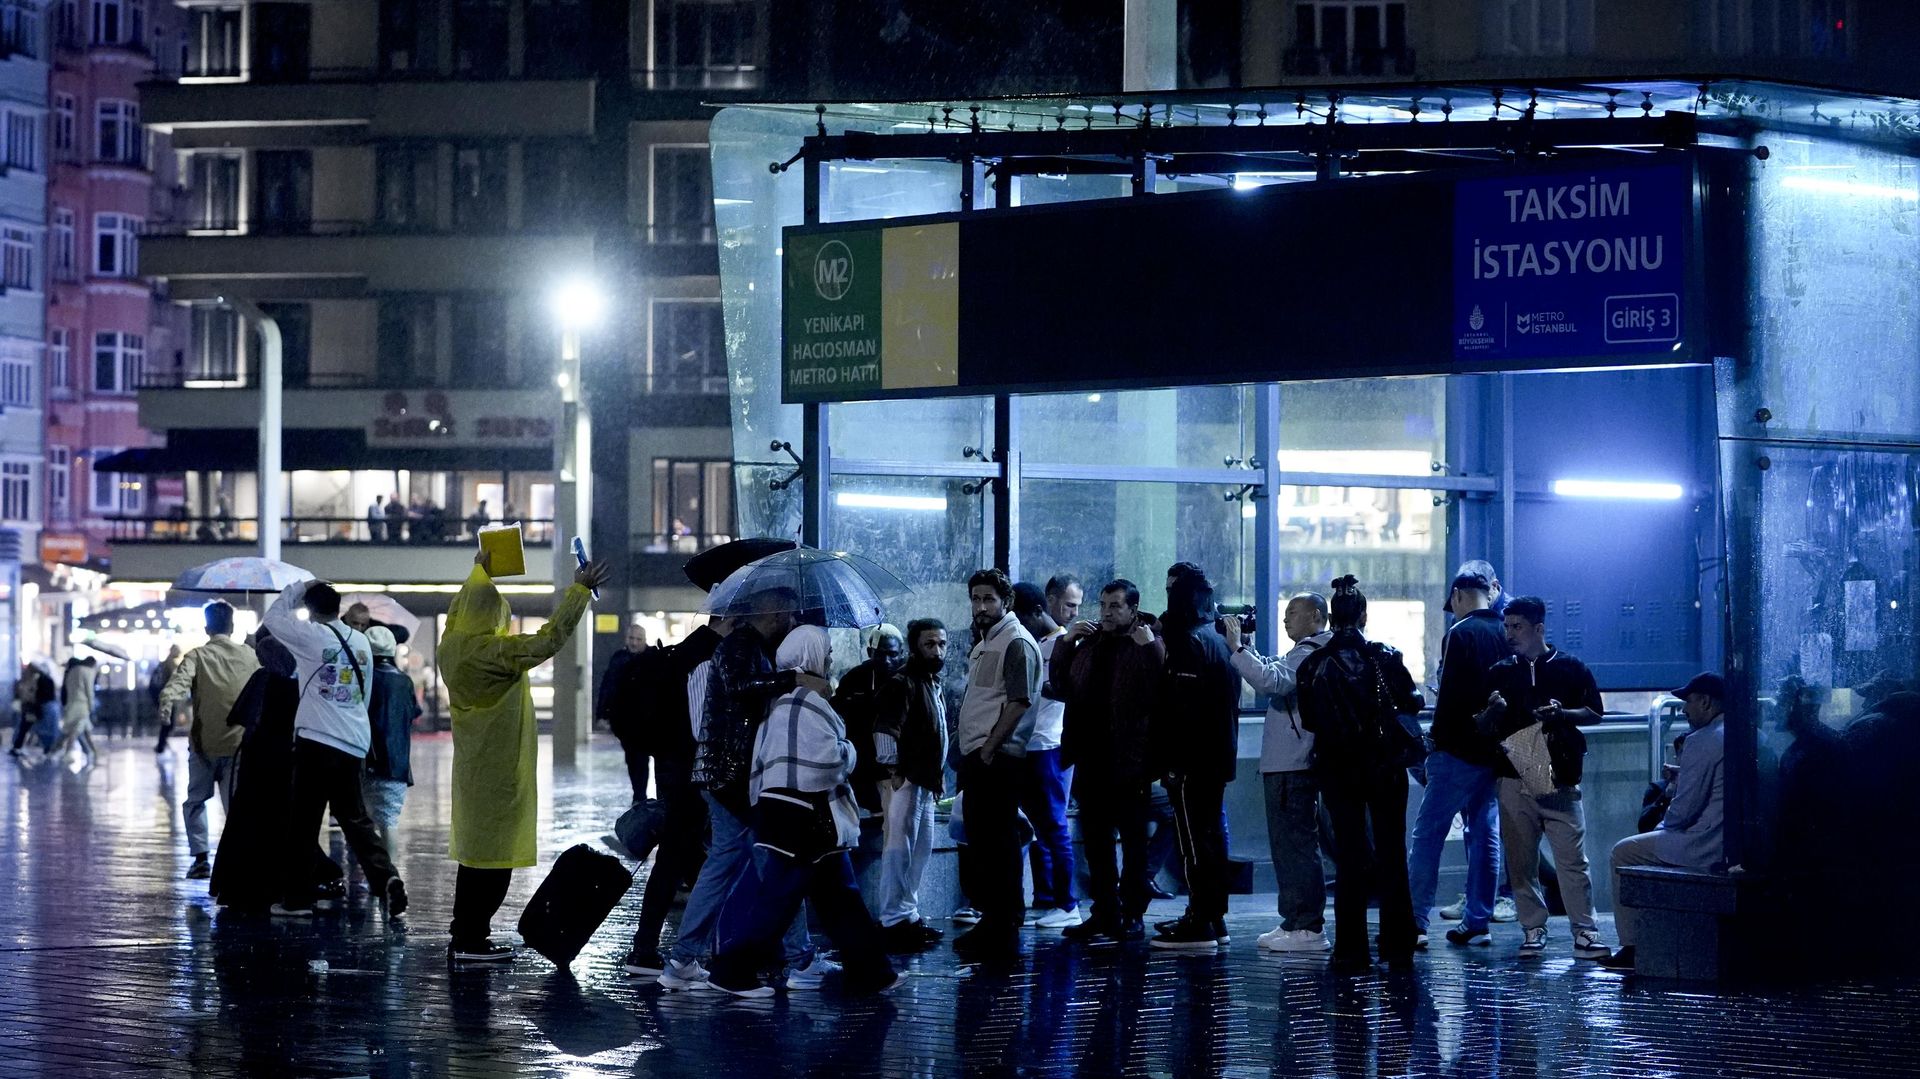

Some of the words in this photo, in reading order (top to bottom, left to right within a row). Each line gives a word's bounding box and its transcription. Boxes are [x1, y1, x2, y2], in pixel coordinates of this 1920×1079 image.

[1504, 176, 1630, 223] TAKSİM
[1474, 235, 1663, 279] İSTASYONU
[819, 258, 848, 284] M2
[804, 312, 864, 334] YENİKAPI
[1531, 311, 1565, 322] METRO
[1611, 306, 1655, 332] GİRİŞ
[1661, 308, 1671, 327] 3
[793, 340, 876, 360] HACIOSMAN
[790, 367, 837, 385] METRO
[841, 364, 879, 383] HATTI
